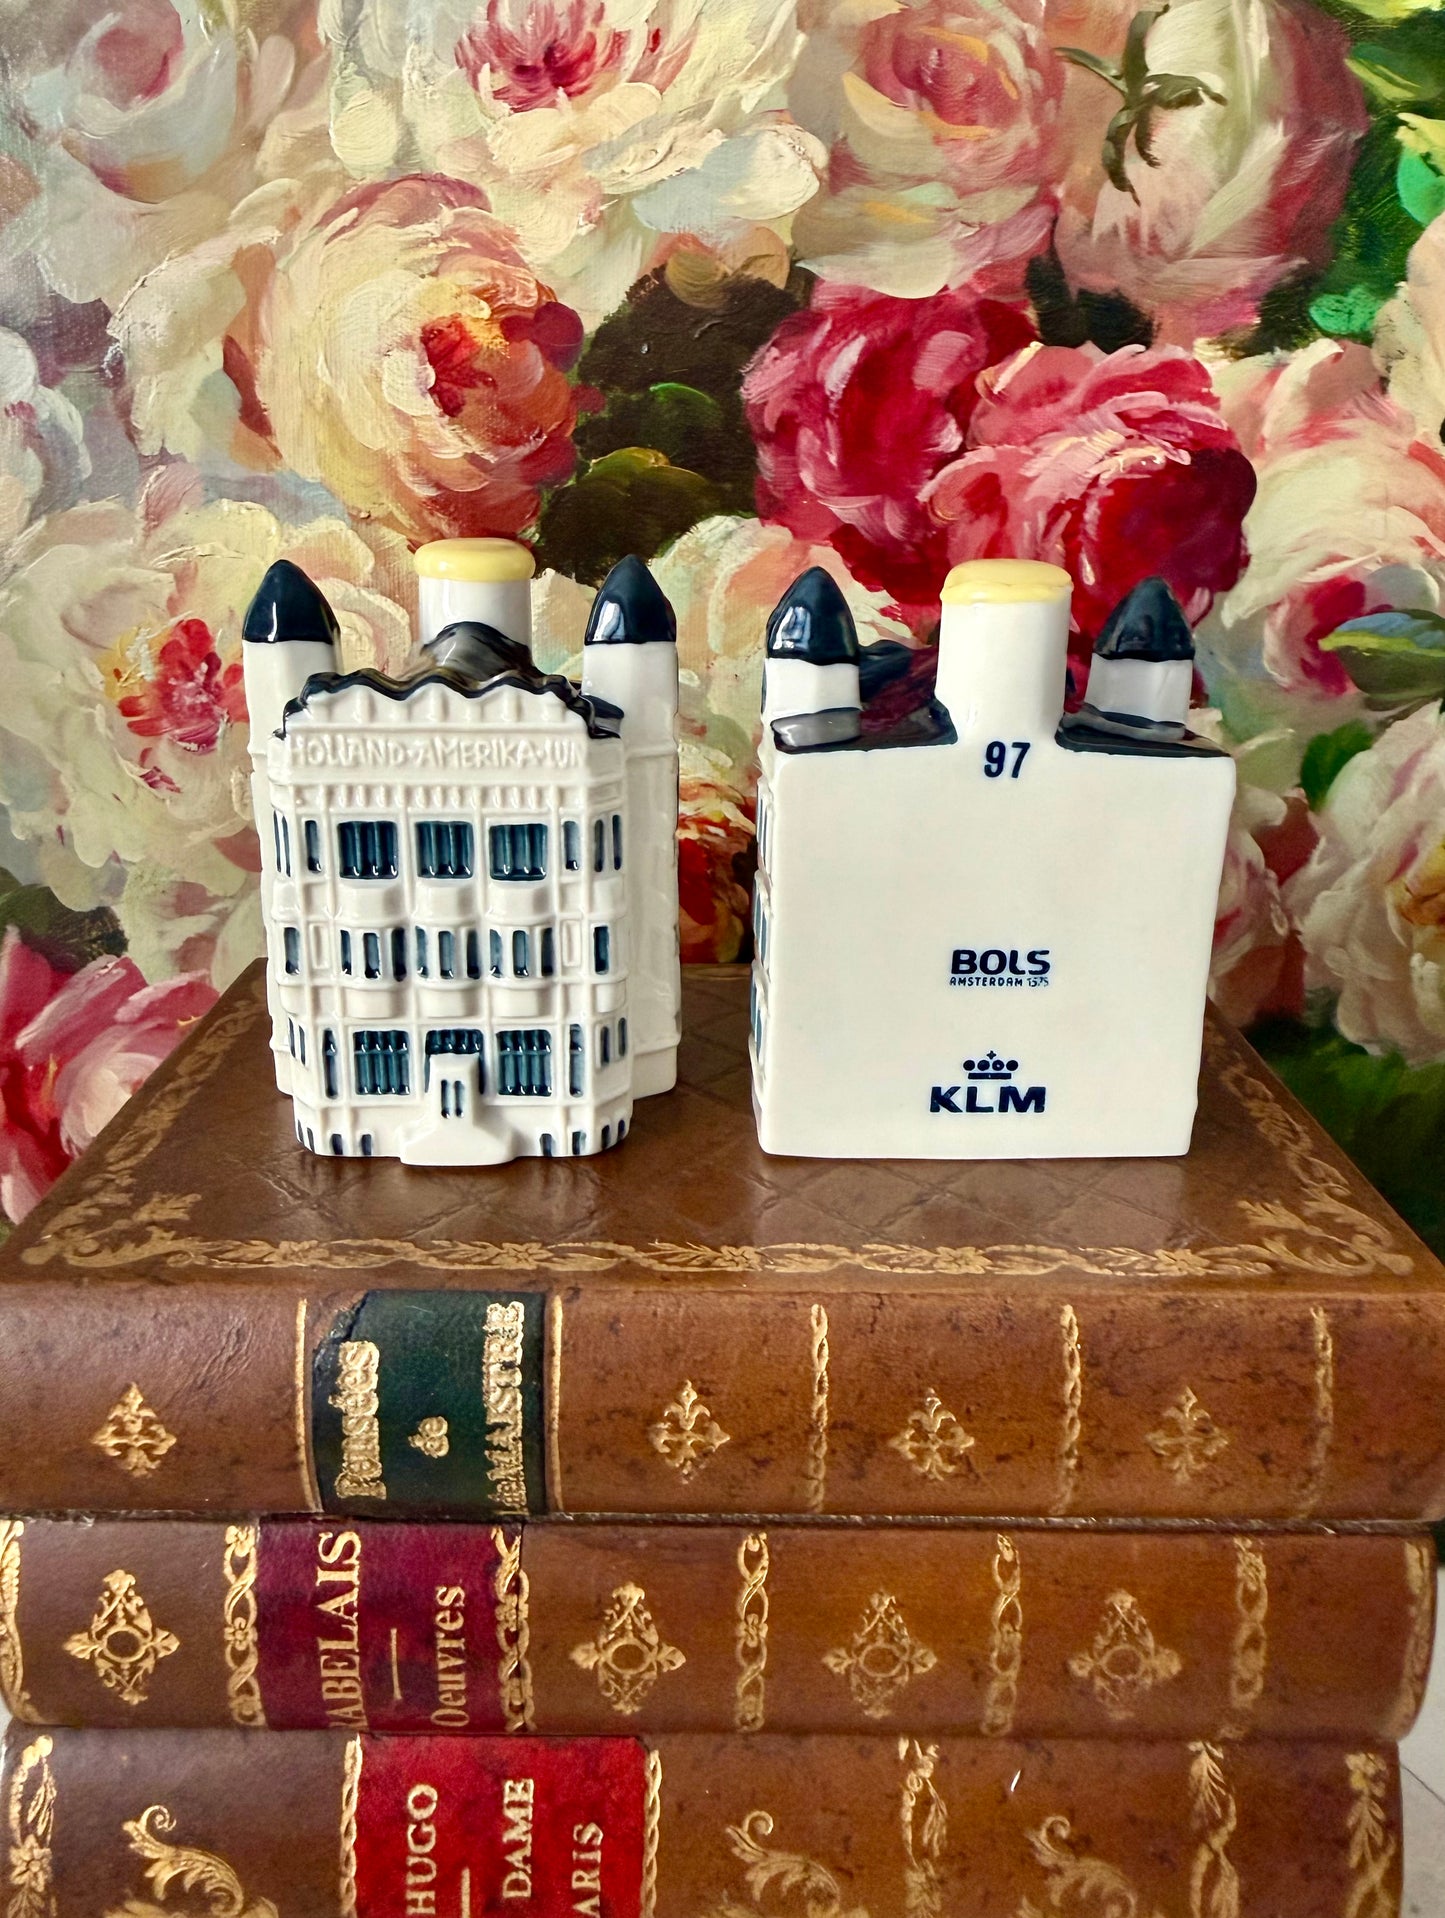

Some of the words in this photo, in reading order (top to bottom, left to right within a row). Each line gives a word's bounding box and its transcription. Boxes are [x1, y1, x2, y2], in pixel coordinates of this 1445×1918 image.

[983, 740, 1031, 779] 97
[949, 976, 1024, 987] AMSTERDAM
[950, 949, 1052, 975] BOLS
[930, 1086, 1047, 1113] KLM
[430, 1585, 470, 1728] Oeuvres
[406, 1783, 438, 1916] HUGO
[502, 1778, 535, 1899] DAME
